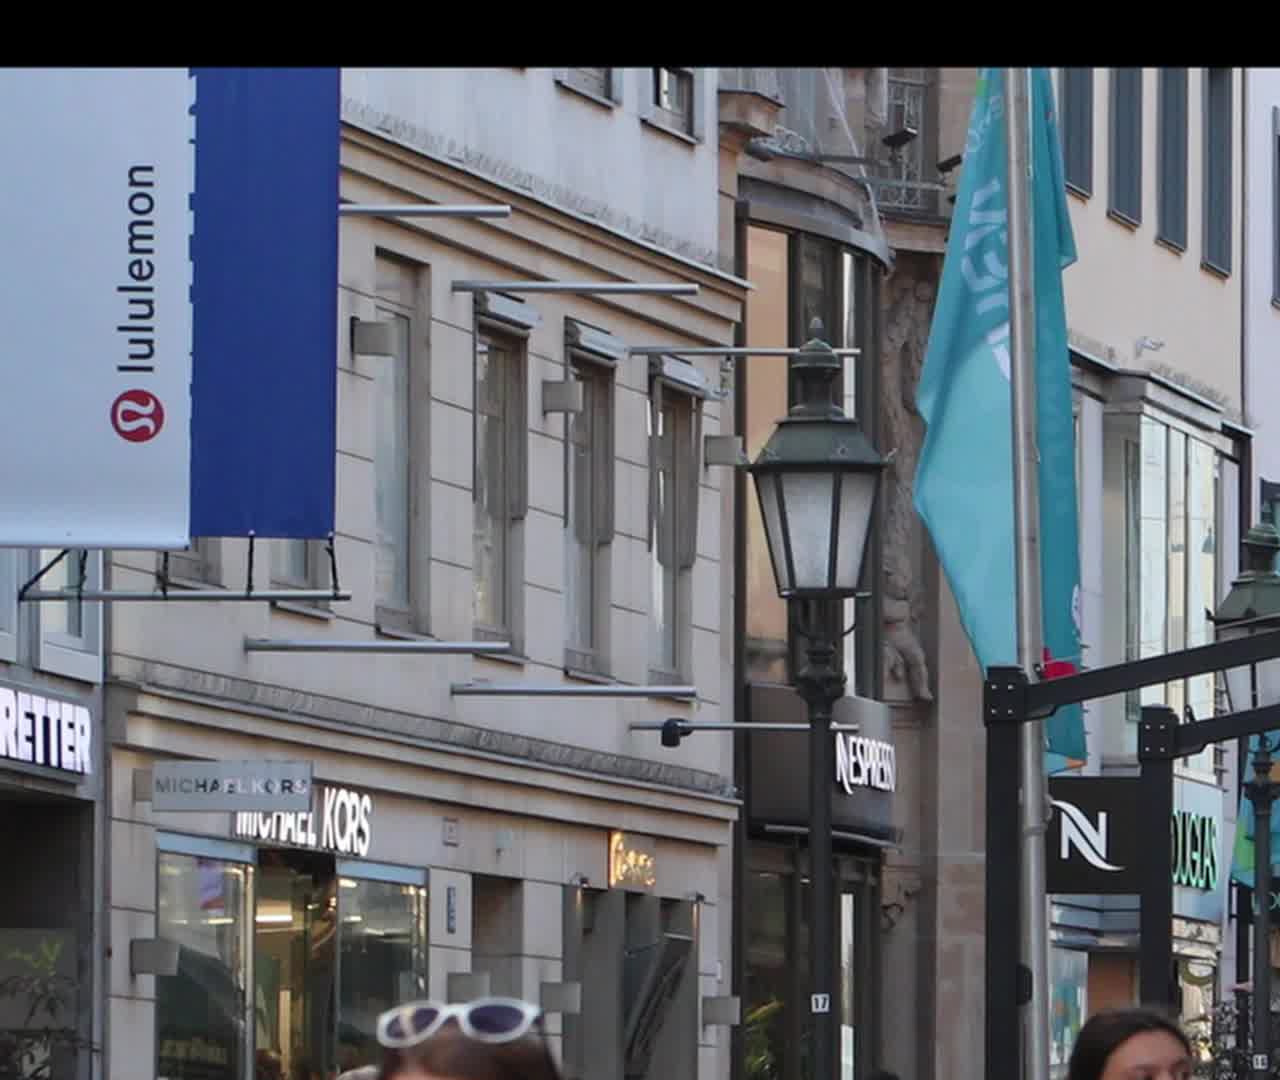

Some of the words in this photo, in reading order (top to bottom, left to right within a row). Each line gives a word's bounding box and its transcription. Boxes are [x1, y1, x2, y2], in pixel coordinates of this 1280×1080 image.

[117, 164, 155, 372] lululemon
[155, 777, 248, 794] MICHAEL
[251, 777, 308, 794] KORS
[322, 786, 372, 857] KORS
